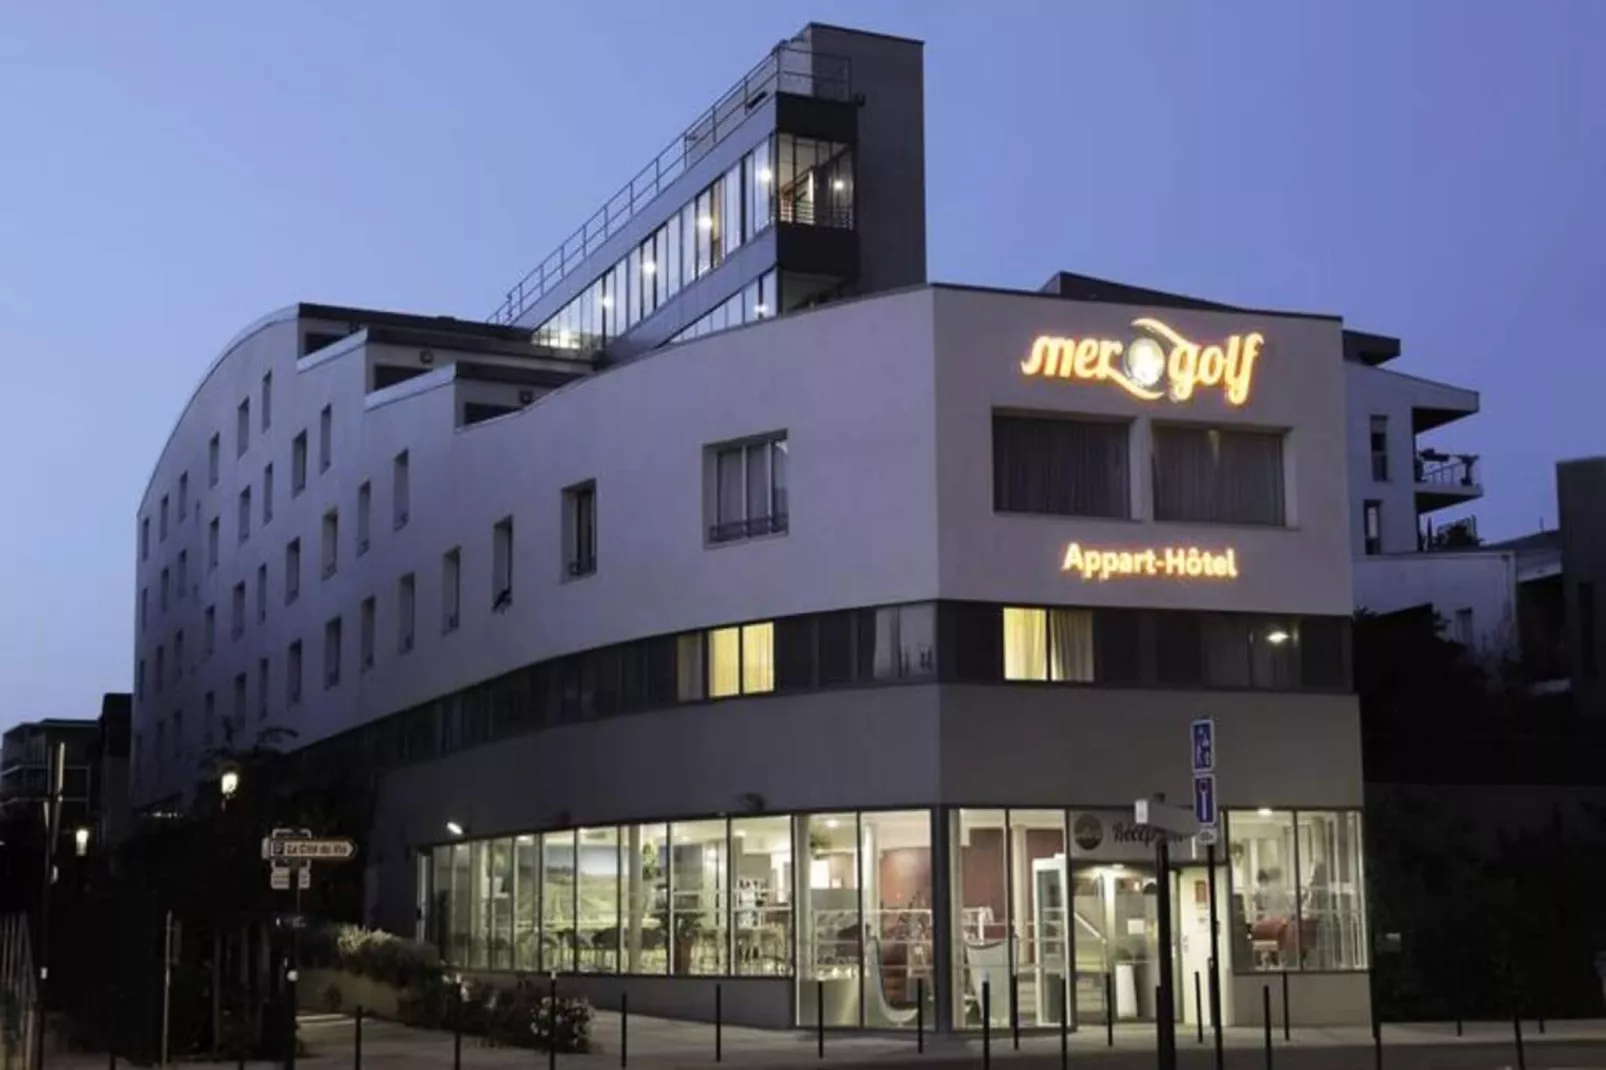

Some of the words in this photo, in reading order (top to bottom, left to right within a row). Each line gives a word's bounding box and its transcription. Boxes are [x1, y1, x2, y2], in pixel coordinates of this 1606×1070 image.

[1020, 335, 1125, 382] mer
[1167, 332, 1265, 405] golf
[1061, 542, 1238, 580] Appart-Hôtel
